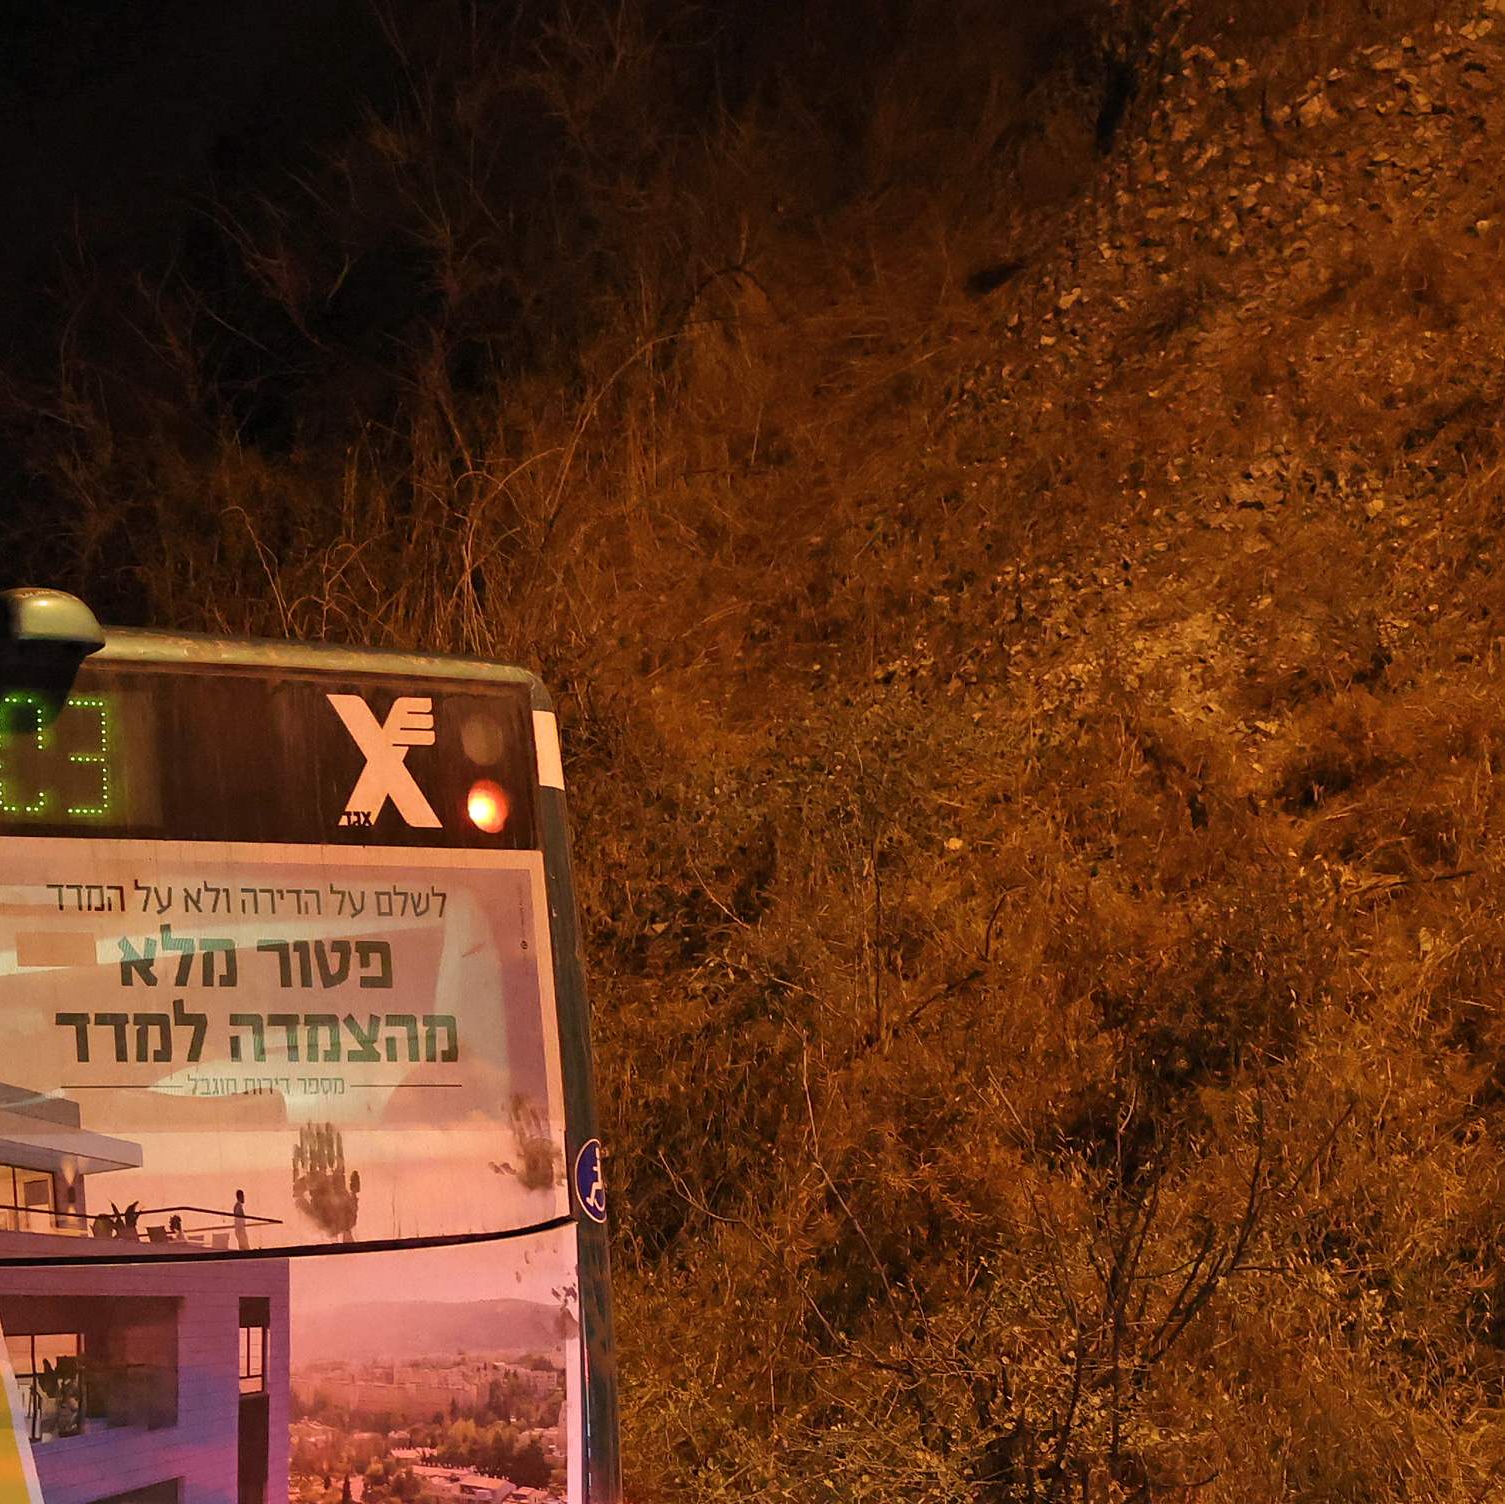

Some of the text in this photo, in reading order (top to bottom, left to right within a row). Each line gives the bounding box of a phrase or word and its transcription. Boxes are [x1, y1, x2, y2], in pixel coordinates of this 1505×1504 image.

[343, 811, 373, 827] אגד
[46, 879, 447, 918] לשלם על הדירה ולא על המדד
[117, 923, 393, 989] פטור מלא
[54, 999, 459, 1064] מהצמדה למדד
[186, 1073, 345, 1096] מספר דירות מוגבל
